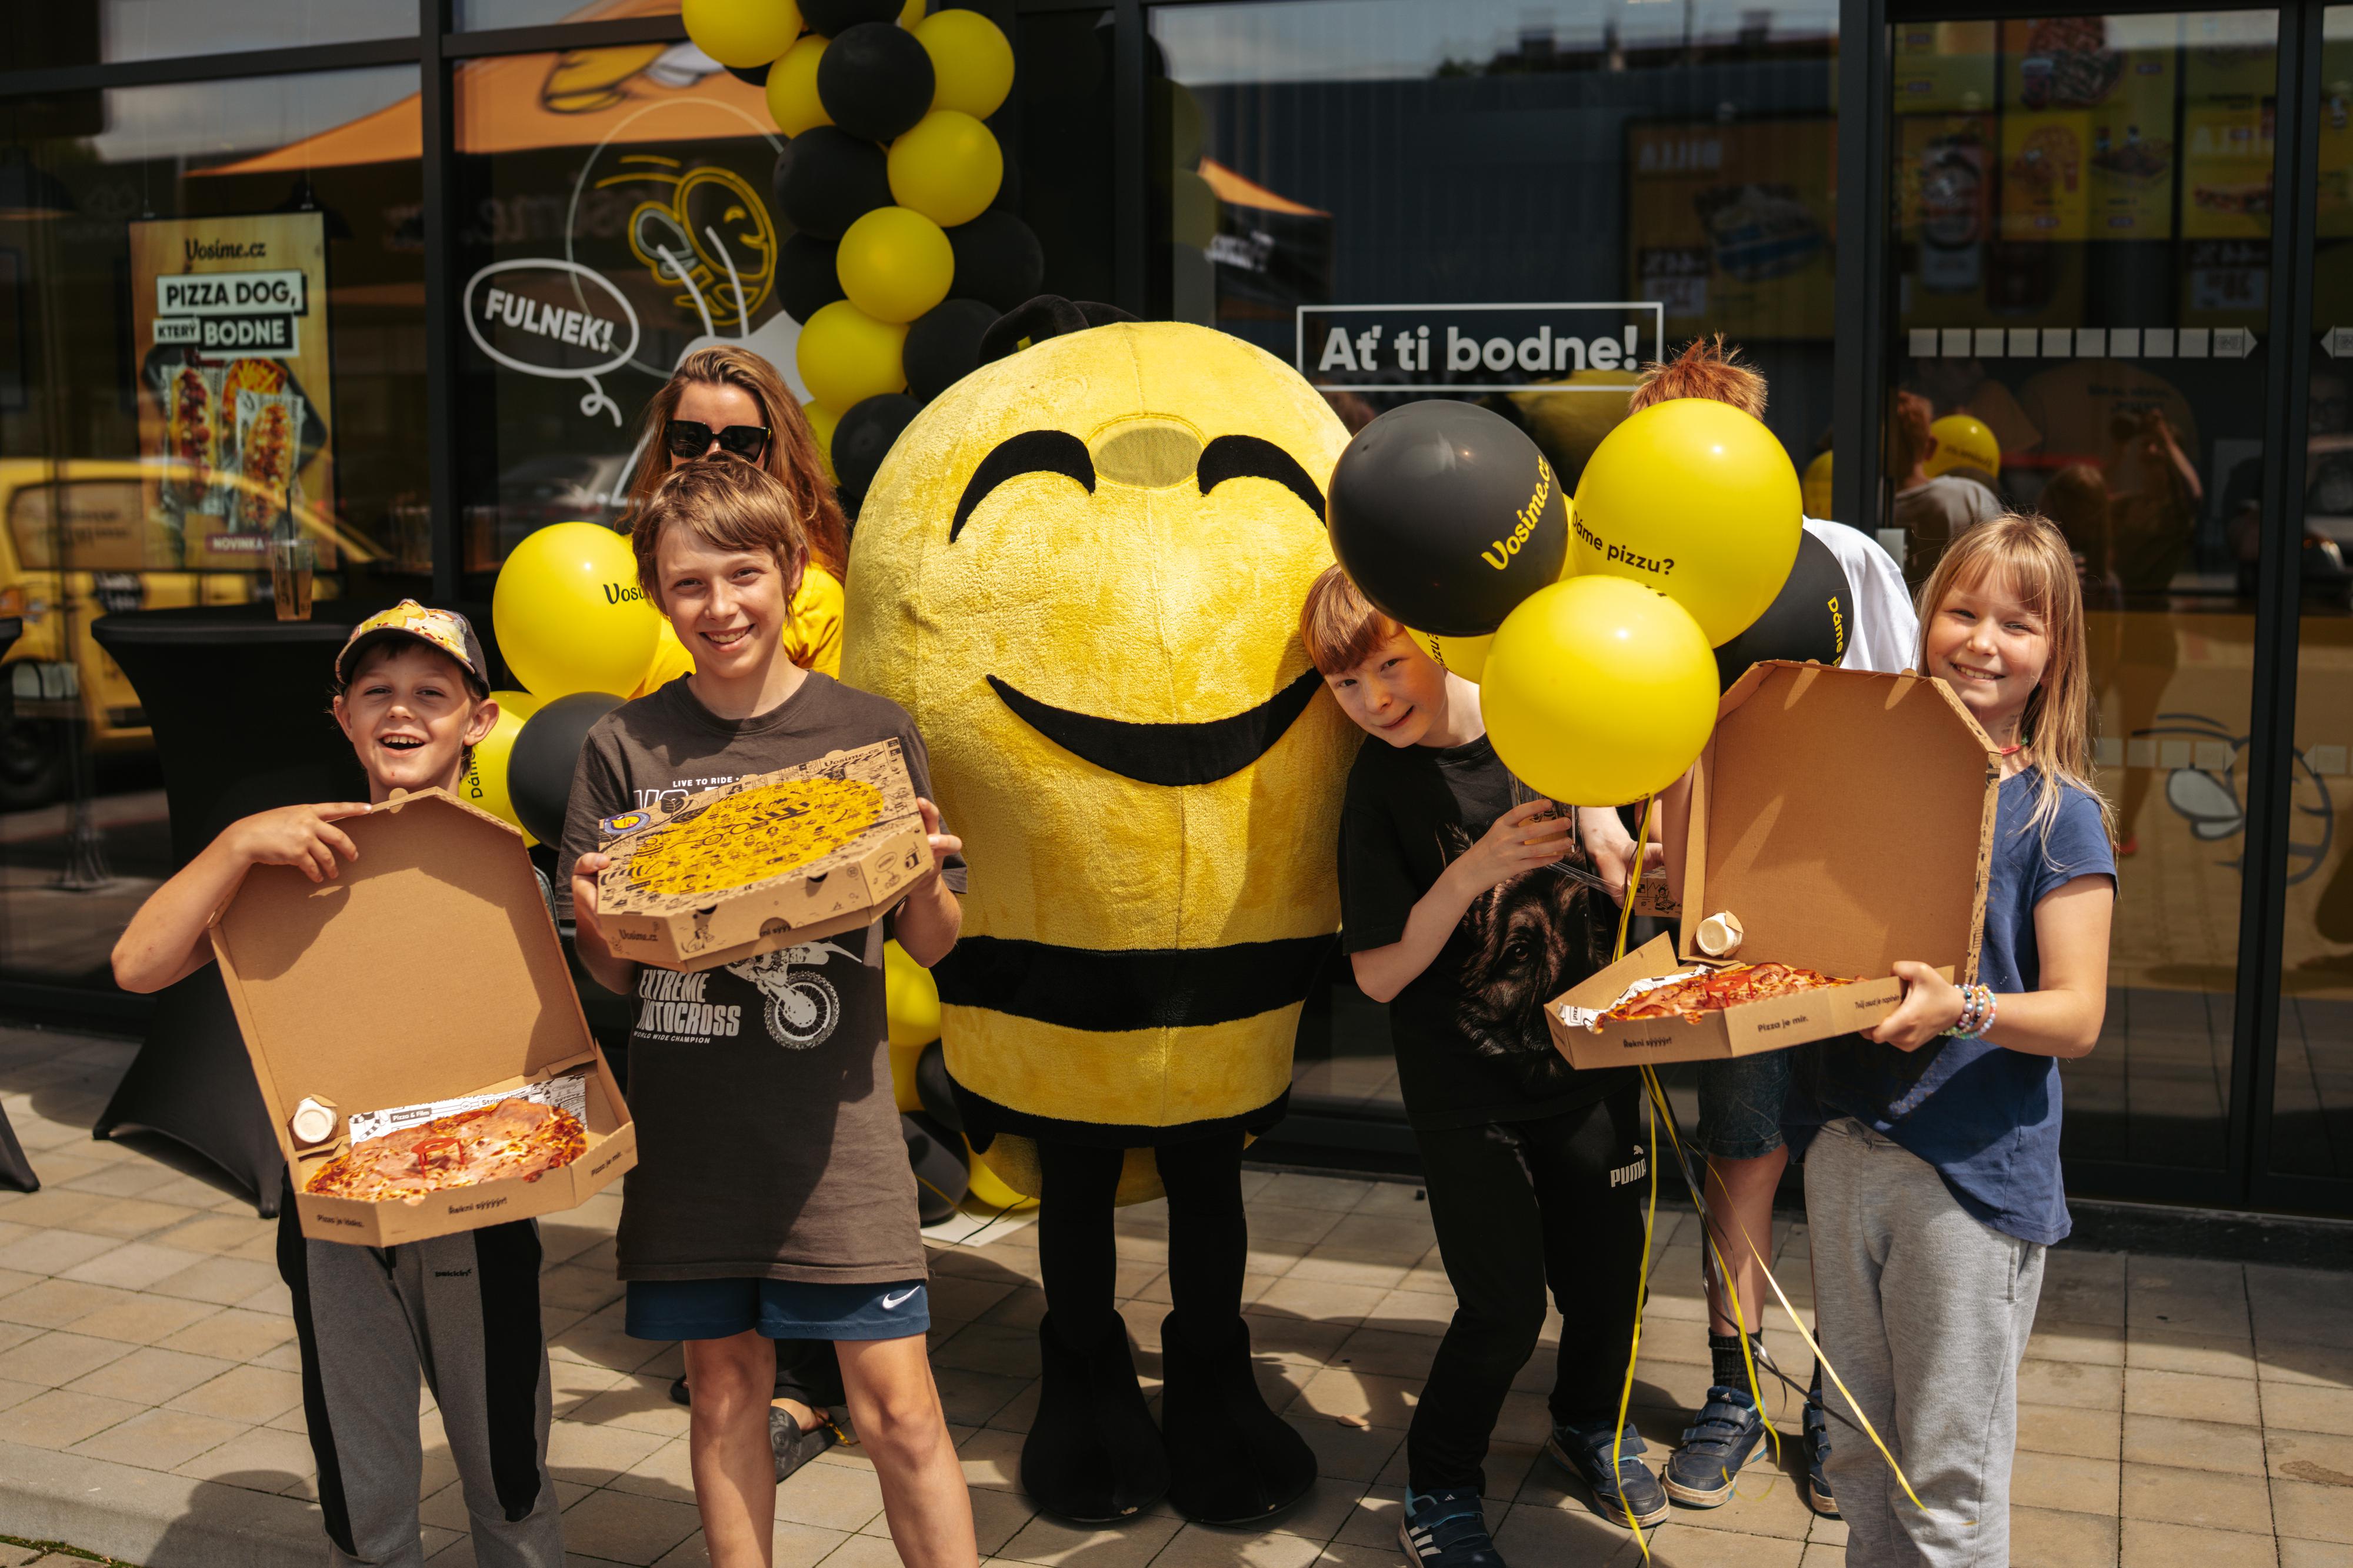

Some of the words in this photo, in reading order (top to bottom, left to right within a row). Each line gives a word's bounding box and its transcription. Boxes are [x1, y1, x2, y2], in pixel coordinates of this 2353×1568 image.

[166, 283, 229, 308] PIZZA
[235, 279, 296, 307] DOG,
[158, 319, 197, 339] KTERÝ
[204, 319, 285, 347] BODNE
[484, 288, 615, 353] FULNEK!
[1318, 324, 1383, 372] Ať
[1394, 324, 1430, 372] ti
[1447, 324, 1639, 372] bodne!
[212, 536, 265, 553] NOVINKA
[1572, 509, 1603, 551] Dáme
[1607, 544, 1675, 576] pizzu?
[1827, 596, 1843, 653] Dáme
[672, 779, 693, 788] LIVE
[711, 776, 733, 785] RIDE
[639, 969, 711, 1002] EXTREME
[636, 999, 742, 1037] MOTOCROSS
[1757, 1022, 1780, 1032] Pizza
[1782, 1019, 1791, 1029] je
[633, 1030, 651, 1039] WORLD
[652, 1033, 669, 1042] WIDE
[671, 1035, 711, 1044] CHAMPION
[1610, 1157, 1647, 1188] PUMA
